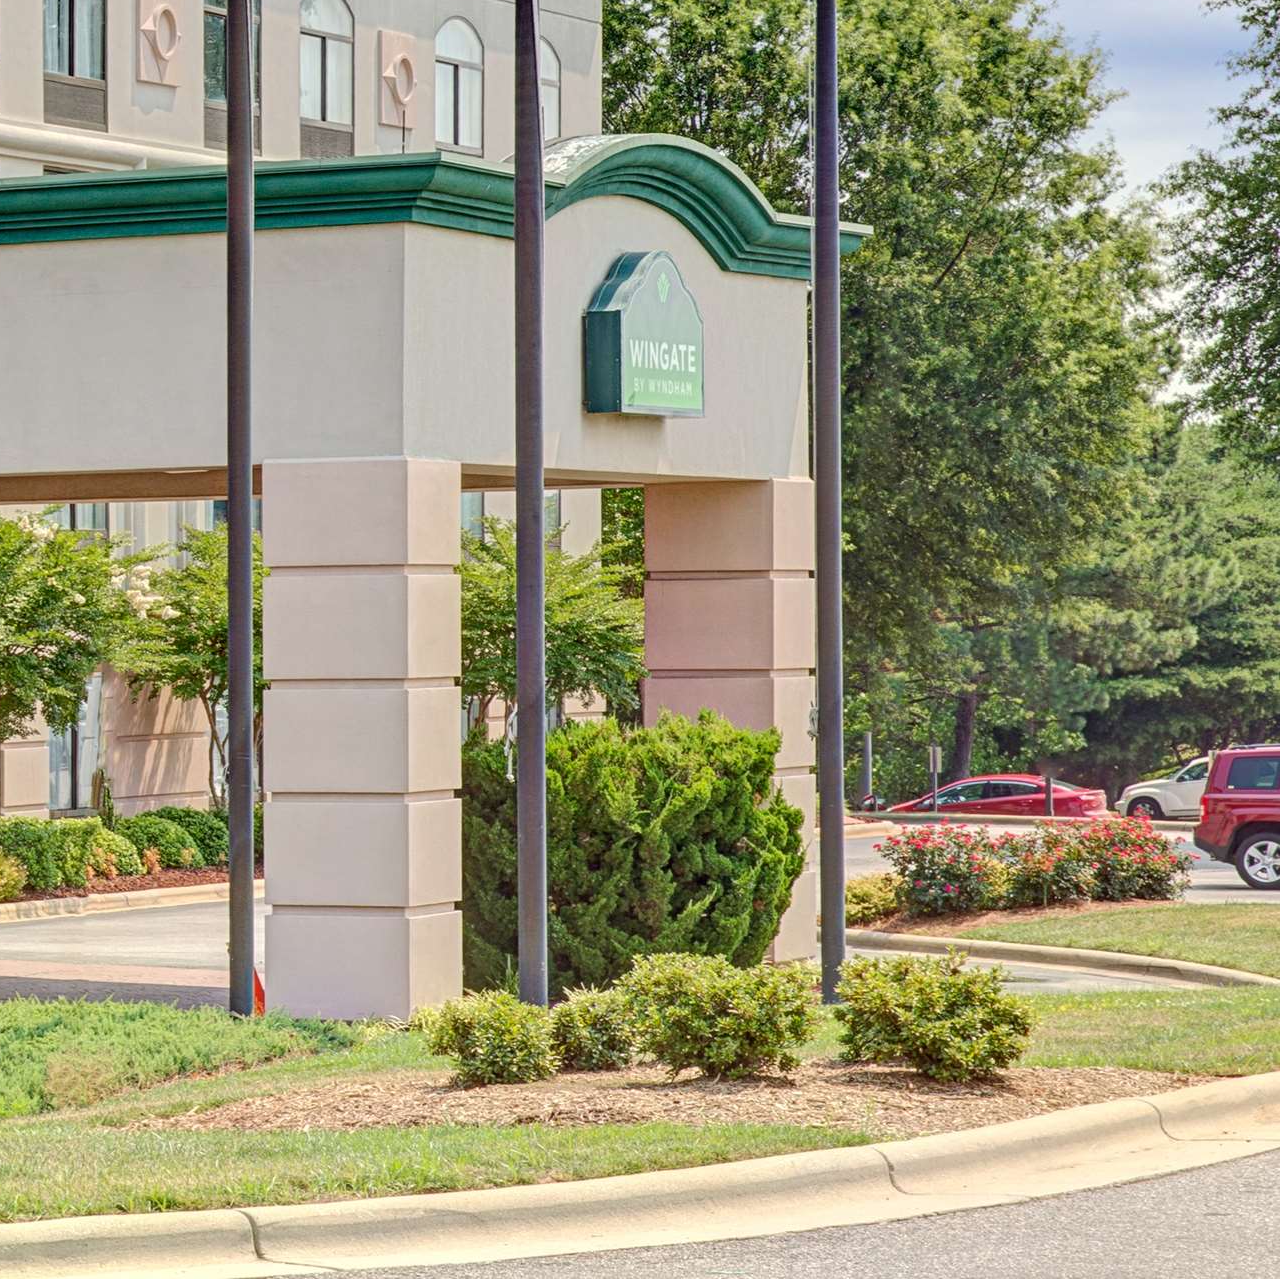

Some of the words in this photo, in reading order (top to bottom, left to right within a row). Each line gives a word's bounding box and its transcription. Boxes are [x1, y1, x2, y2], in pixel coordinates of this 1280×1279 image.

[629, 338, 697, 373] WINGATE
[633, 377, 645, 392] BY
[648, 378, 693, 395] WYNDHAM
